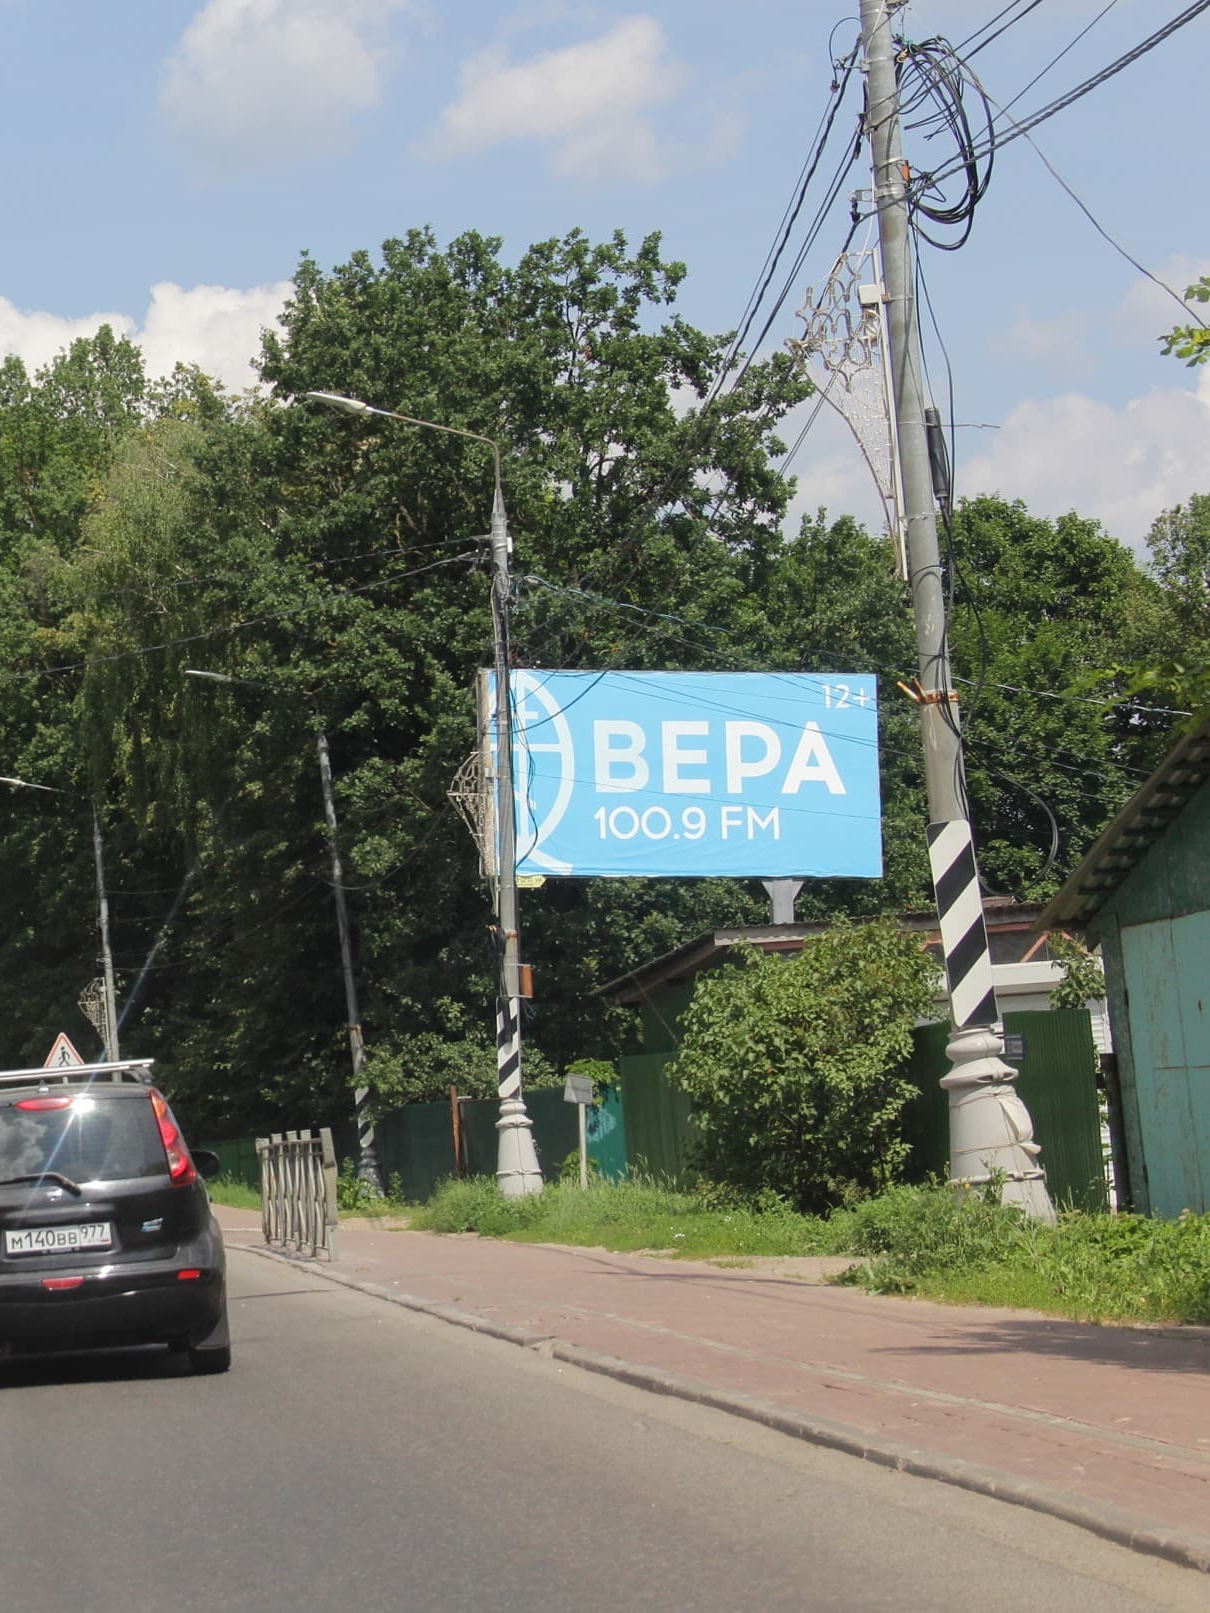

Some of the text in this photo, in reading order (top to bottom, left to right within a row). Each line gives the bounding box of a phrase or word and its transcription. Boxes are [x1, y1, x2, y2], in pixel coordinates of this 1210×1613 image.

[821, 684, 869, 709] 12+
[594, 720, 847, 795] ВЕРА
[593, 806, 780, 840] 100.9 FM
[11, 1225, 105, 1250] М140ВВ 977
